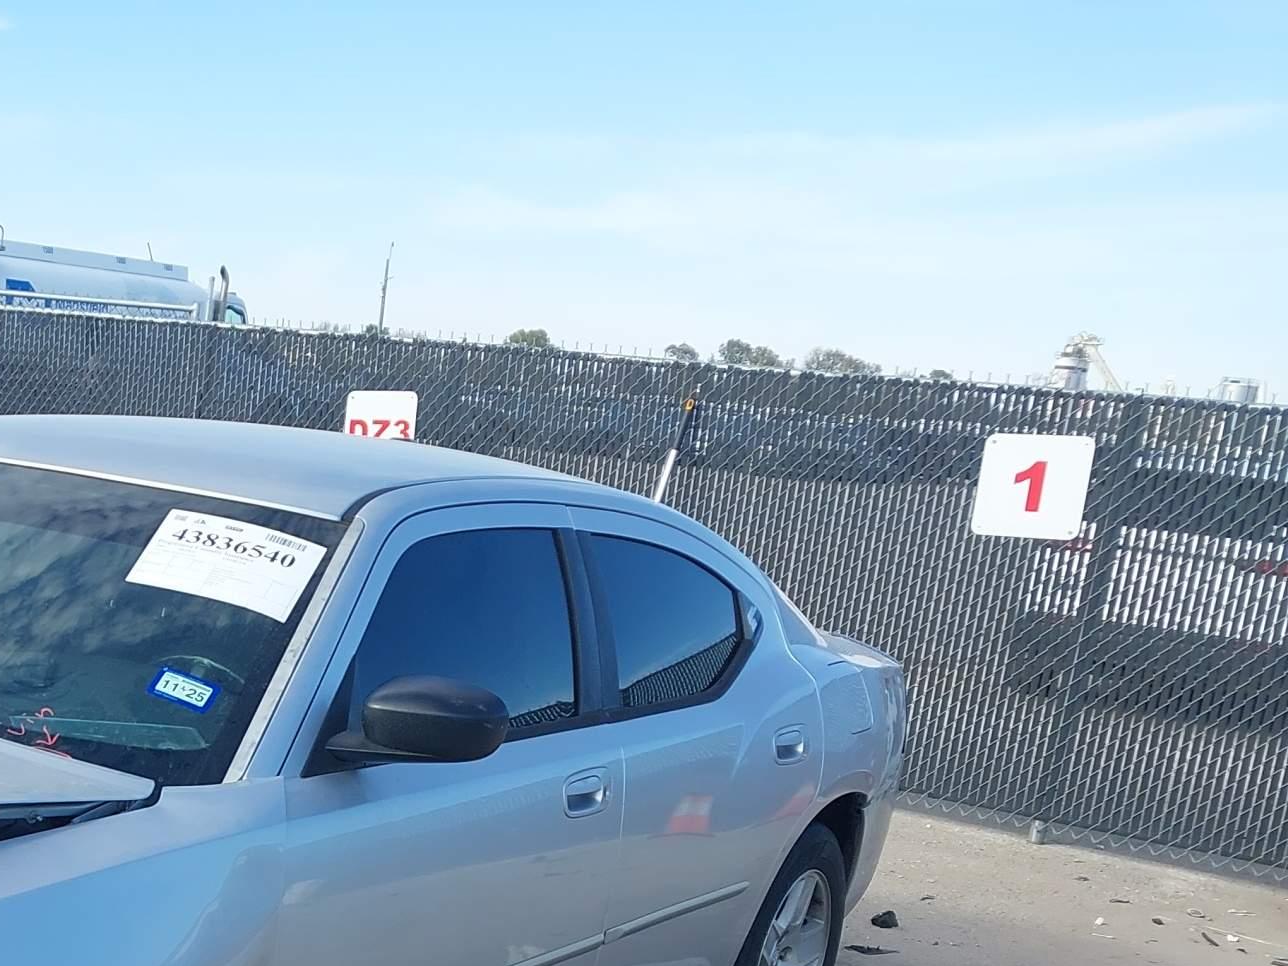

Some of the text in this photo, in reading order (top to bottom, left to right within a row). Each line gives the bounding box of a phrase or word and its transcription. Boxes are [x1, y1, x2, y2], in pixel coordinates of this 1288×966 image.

[349, 419, 410, 440] DZ3
[1014, 461, 1048, 512] 1
[172, 528, 296, 568] 43836540
[162, 680, 207, 703] 11 25
